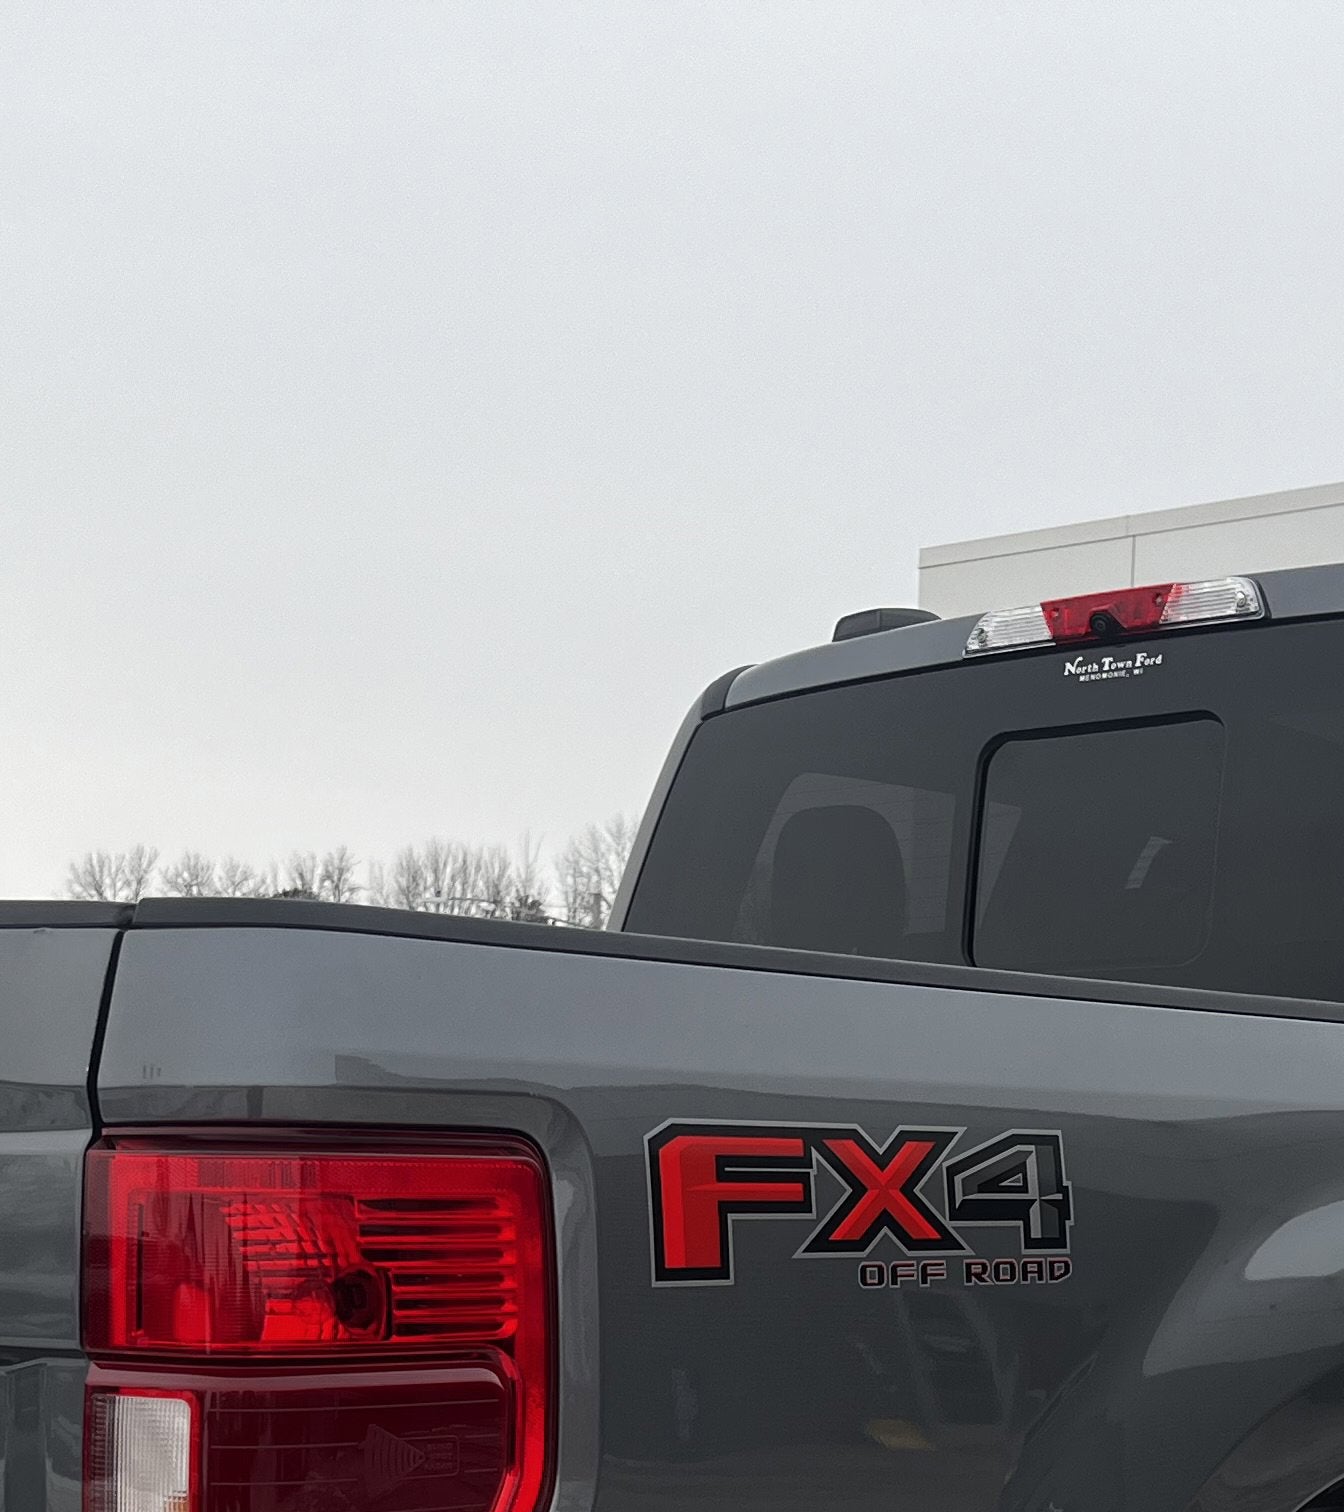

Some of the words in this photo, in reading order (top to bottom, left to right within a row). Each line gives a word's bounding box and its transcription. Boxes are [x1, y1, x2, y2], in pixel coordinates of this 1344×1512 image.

[1063, 656, 1099, 676] North
[1101, 657, 1133, 671] Town
[1135, 652, 1163, 668] Ford
[643, 1118, 1074, 1287] FX4
[857, 1259, 948, 1289] OFF
[963, 1256, 1073, 1287] ROAD
